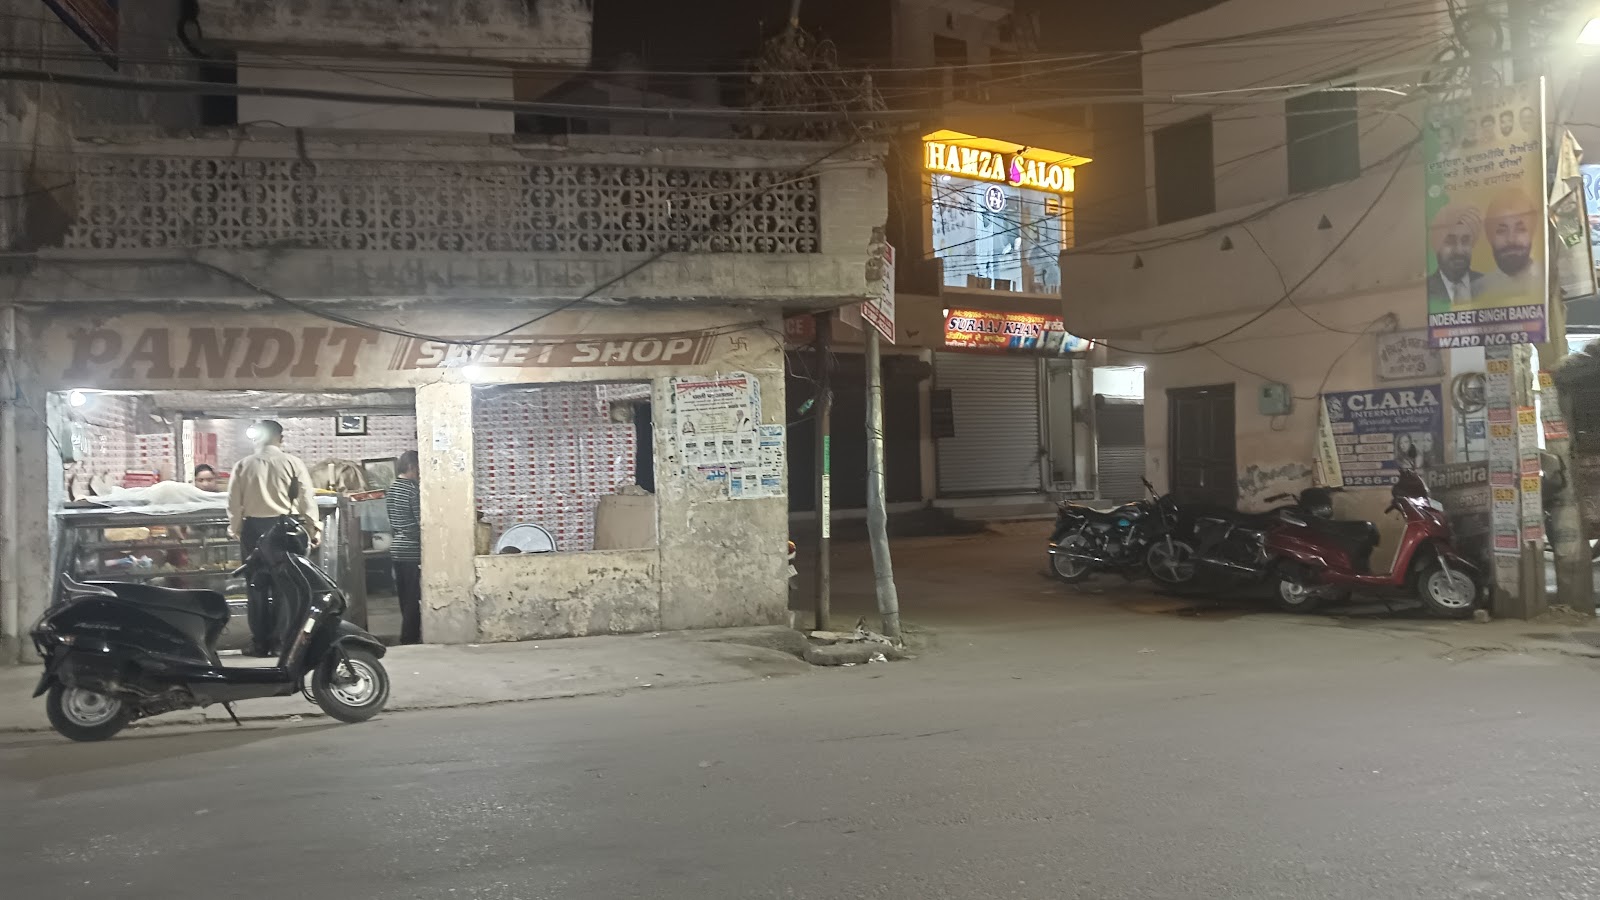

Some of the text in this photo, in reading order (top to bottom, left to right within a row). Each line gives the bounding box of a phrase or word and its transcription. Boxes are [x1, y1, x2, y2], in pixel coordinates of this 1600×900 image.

[925, 142, 1075, 192] HAMZA SALON
[1430, 305, 1544, 326] INDERJEET SINGH BANGA
[949, 317, 1002, 333] SURAAJ
[1003, 322, 1042, 337] KHAN
[1439, 336, 1480, 348] WARD
[62, 327, 380, 380] PANDIT
[571, 339, 692, 363] SHOP
[1347, 389, 1439, 411] CLARA
[1351, 407, 1435, 418] INTERNATIONAL
[1428, 466, 1487, 488] Rajindra
